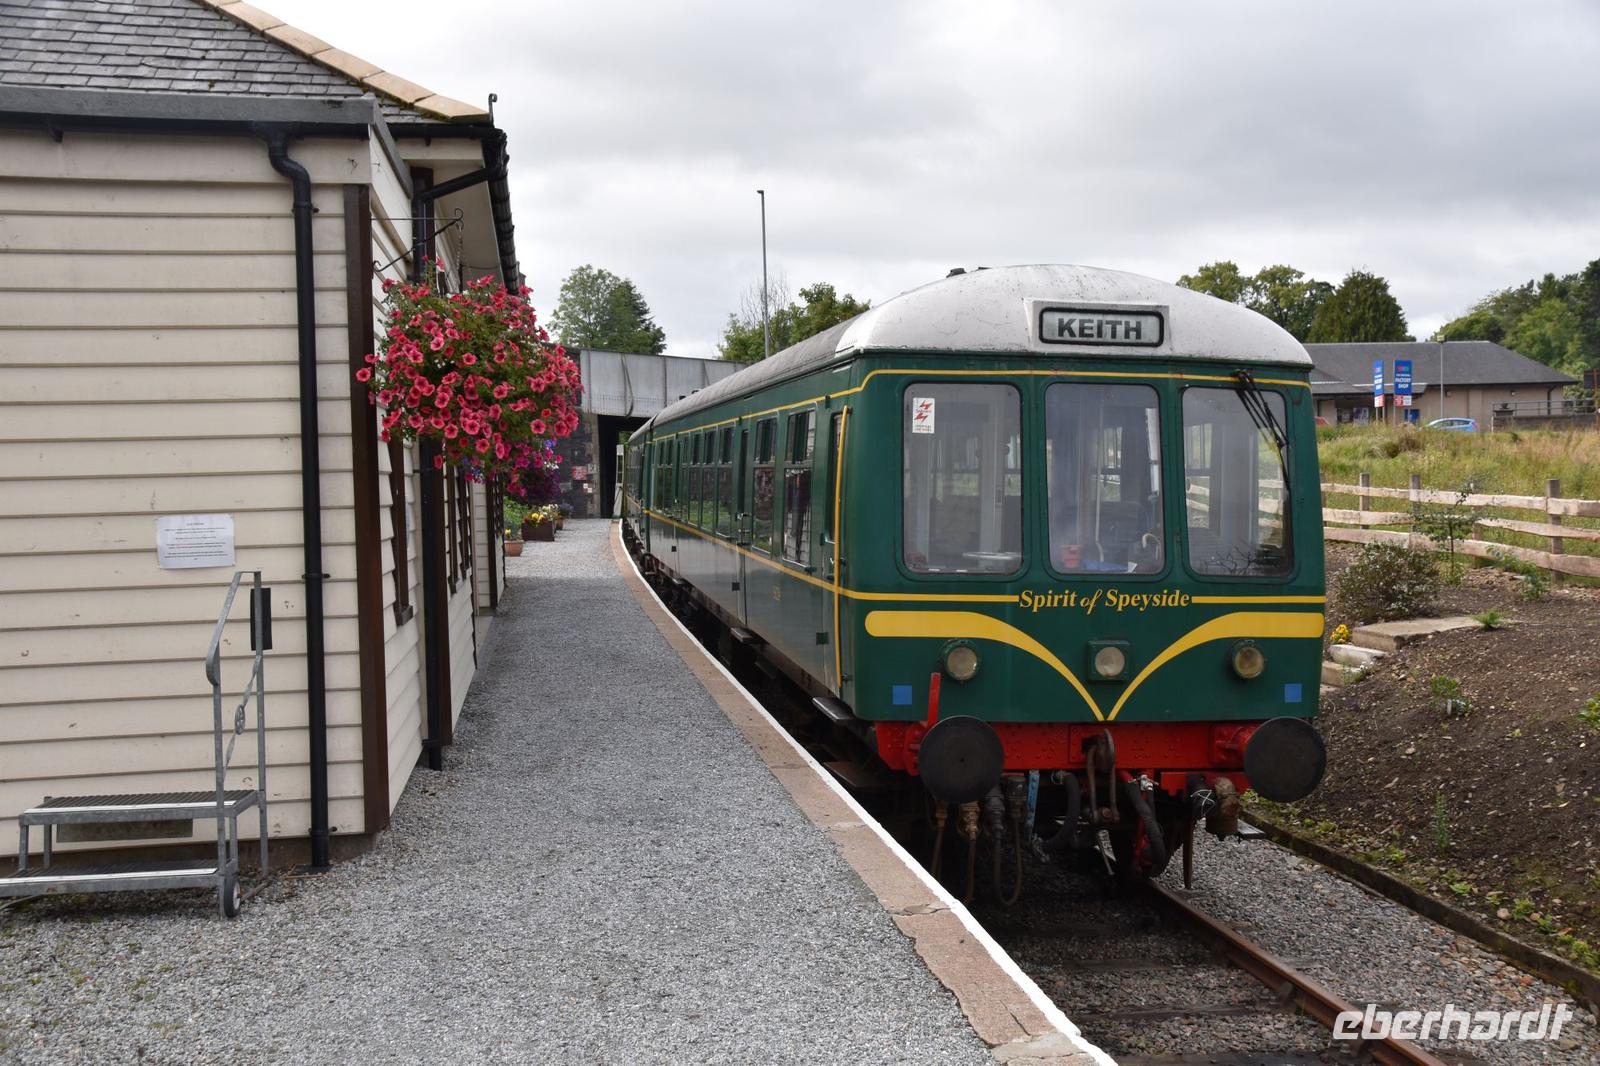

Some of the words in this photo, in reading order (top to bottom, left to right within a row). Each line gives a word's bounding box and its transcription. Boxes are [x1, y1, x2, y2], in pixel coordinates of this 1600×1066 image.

[1057, 317, 1142, 340] KEITH
[1019, 589, 1078, 613] Spirit
[1080, 588, 1103, 615] of
[1104, 588, 1190, 612] Speyside
